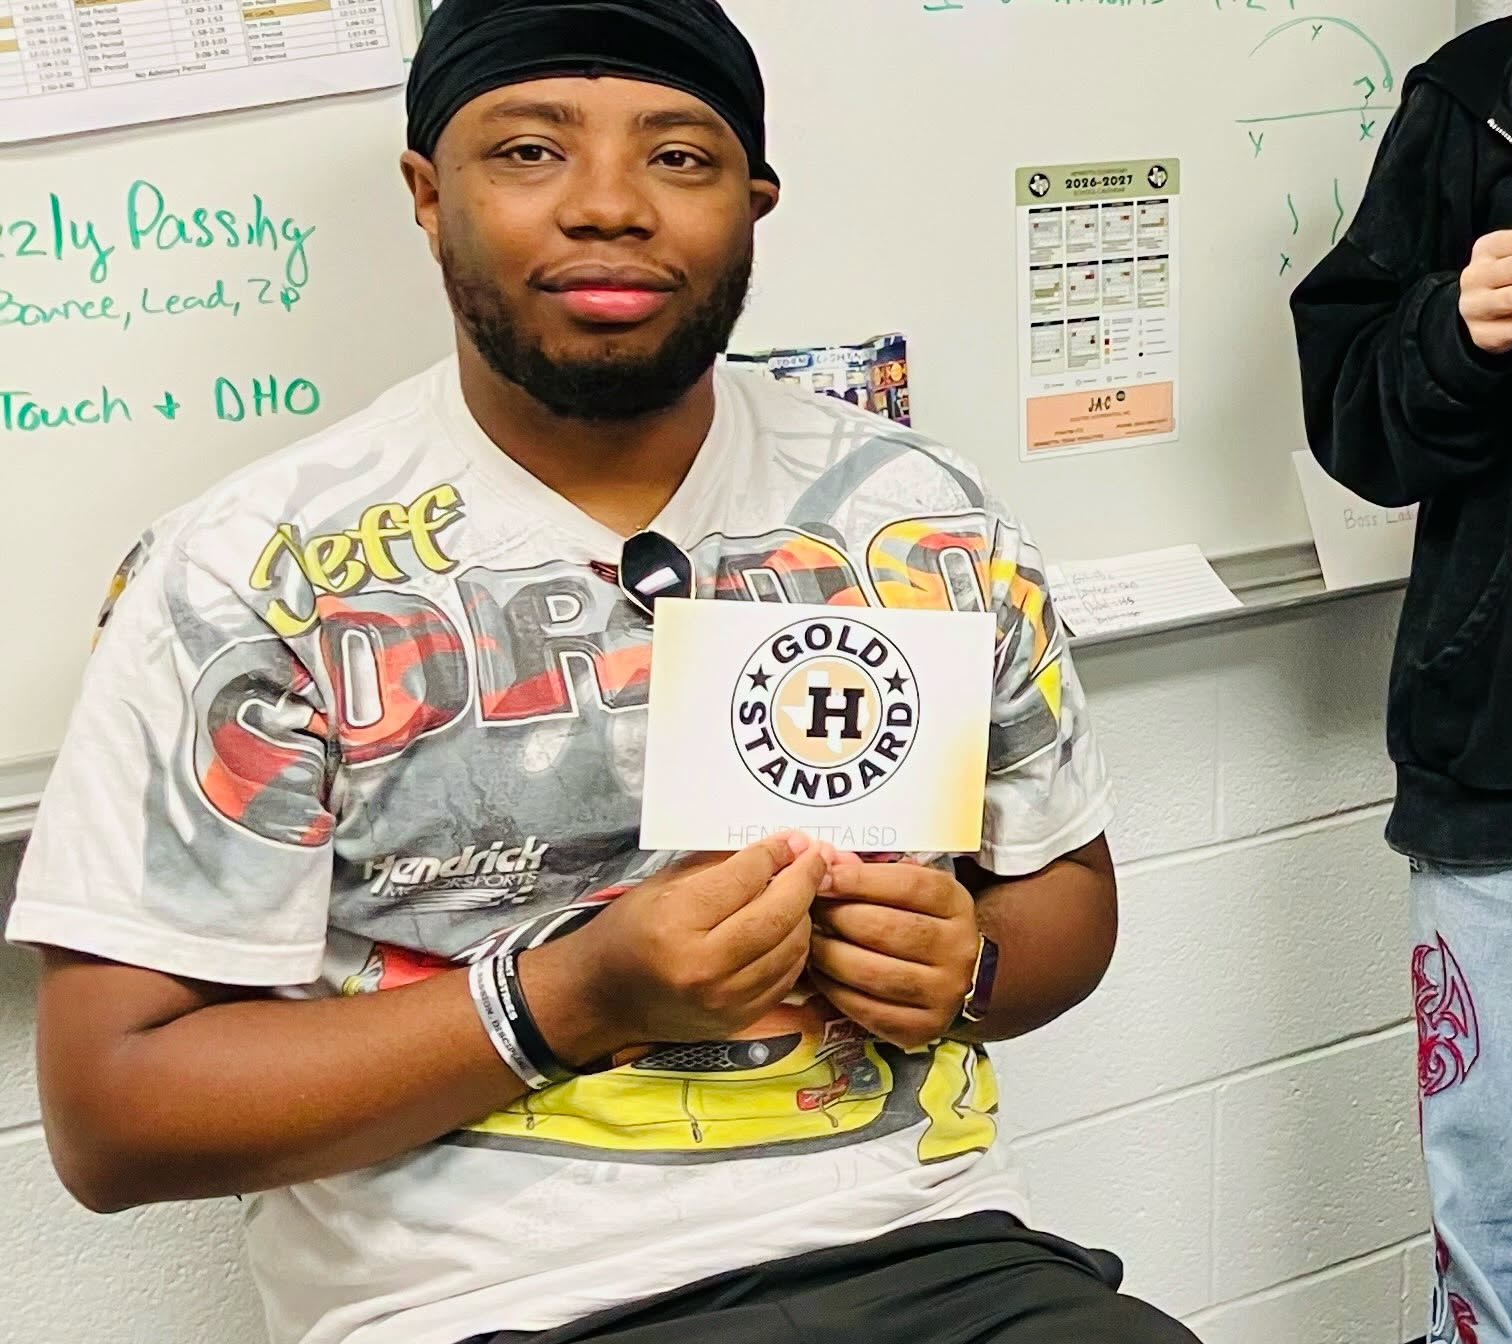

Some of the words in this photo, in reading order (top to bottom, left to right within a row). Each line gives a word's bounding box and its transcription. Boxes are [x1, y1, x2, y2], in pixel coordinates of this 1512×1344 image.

[1065, 174, 1134, 189] 2026-2027
[0, 385, 132, 431] Touch
[215, 374, 321, 422] DHO
[249, 483, 467, 637] Jeff
[771, 623, 889, 668] GOLD
[805, 687, 865, 739] H
[739, 700, 913, 801] STANDARD
[861, 826, 897, 847] ISD
[363, 835, 550, 895] Hendrick
